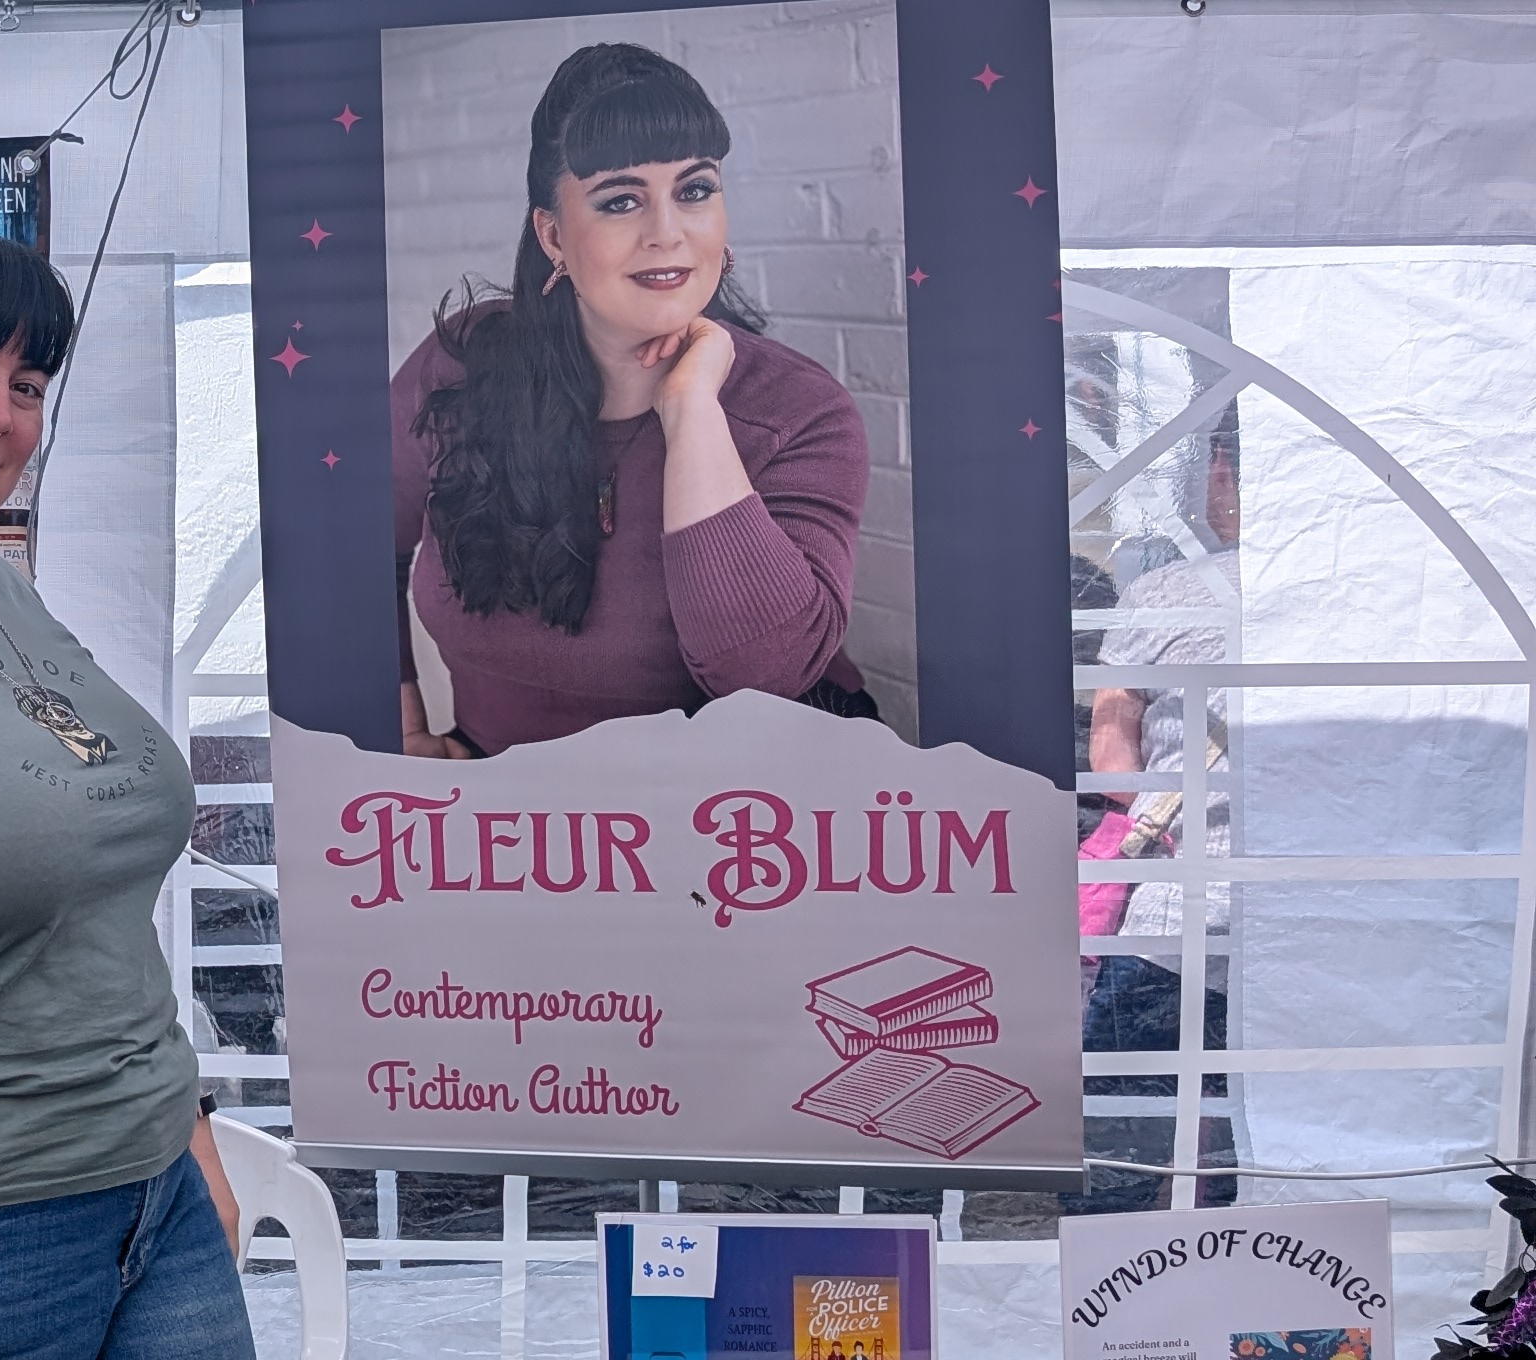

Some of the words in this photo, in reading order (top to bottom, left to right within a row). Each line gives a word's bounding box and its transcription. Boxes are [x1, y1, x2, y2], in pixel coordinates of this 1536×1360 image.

[21, 760, 70, 791] WEST
[87, 778, 135, 801] COAST
[138, 726, 156, 776] ROAST
[325, 787, 657, 909] FLEUR
[693, 789, 1018, 928] BLÜM
[361, 968, 663, 1048] Contemporary
[368, 1060, 518, 1114] Fiction
[529, 1064, 679, 1116] Author
[662, 1237, 673, 1250] 2
[677, 1236, 697, 1253] for
[1072, 1238, 1188, 1328] WINDS
[1197, 1229, 1247, 1260] OF
[1252, 1231, 1386, 1319] CHANGE
[727, 1324, 772, 1335] SAPPHIC
[729, 1307, 736, 1318] A
[739, 1306, 770, 1319] SPICY,
[724, 1341, 777, 1352] ROMANCE
[1103, 1342, 1116, 1351] An
[1119, 1340, 1160, 1350] accident
[1163, 1339, 1181, 1348] and
